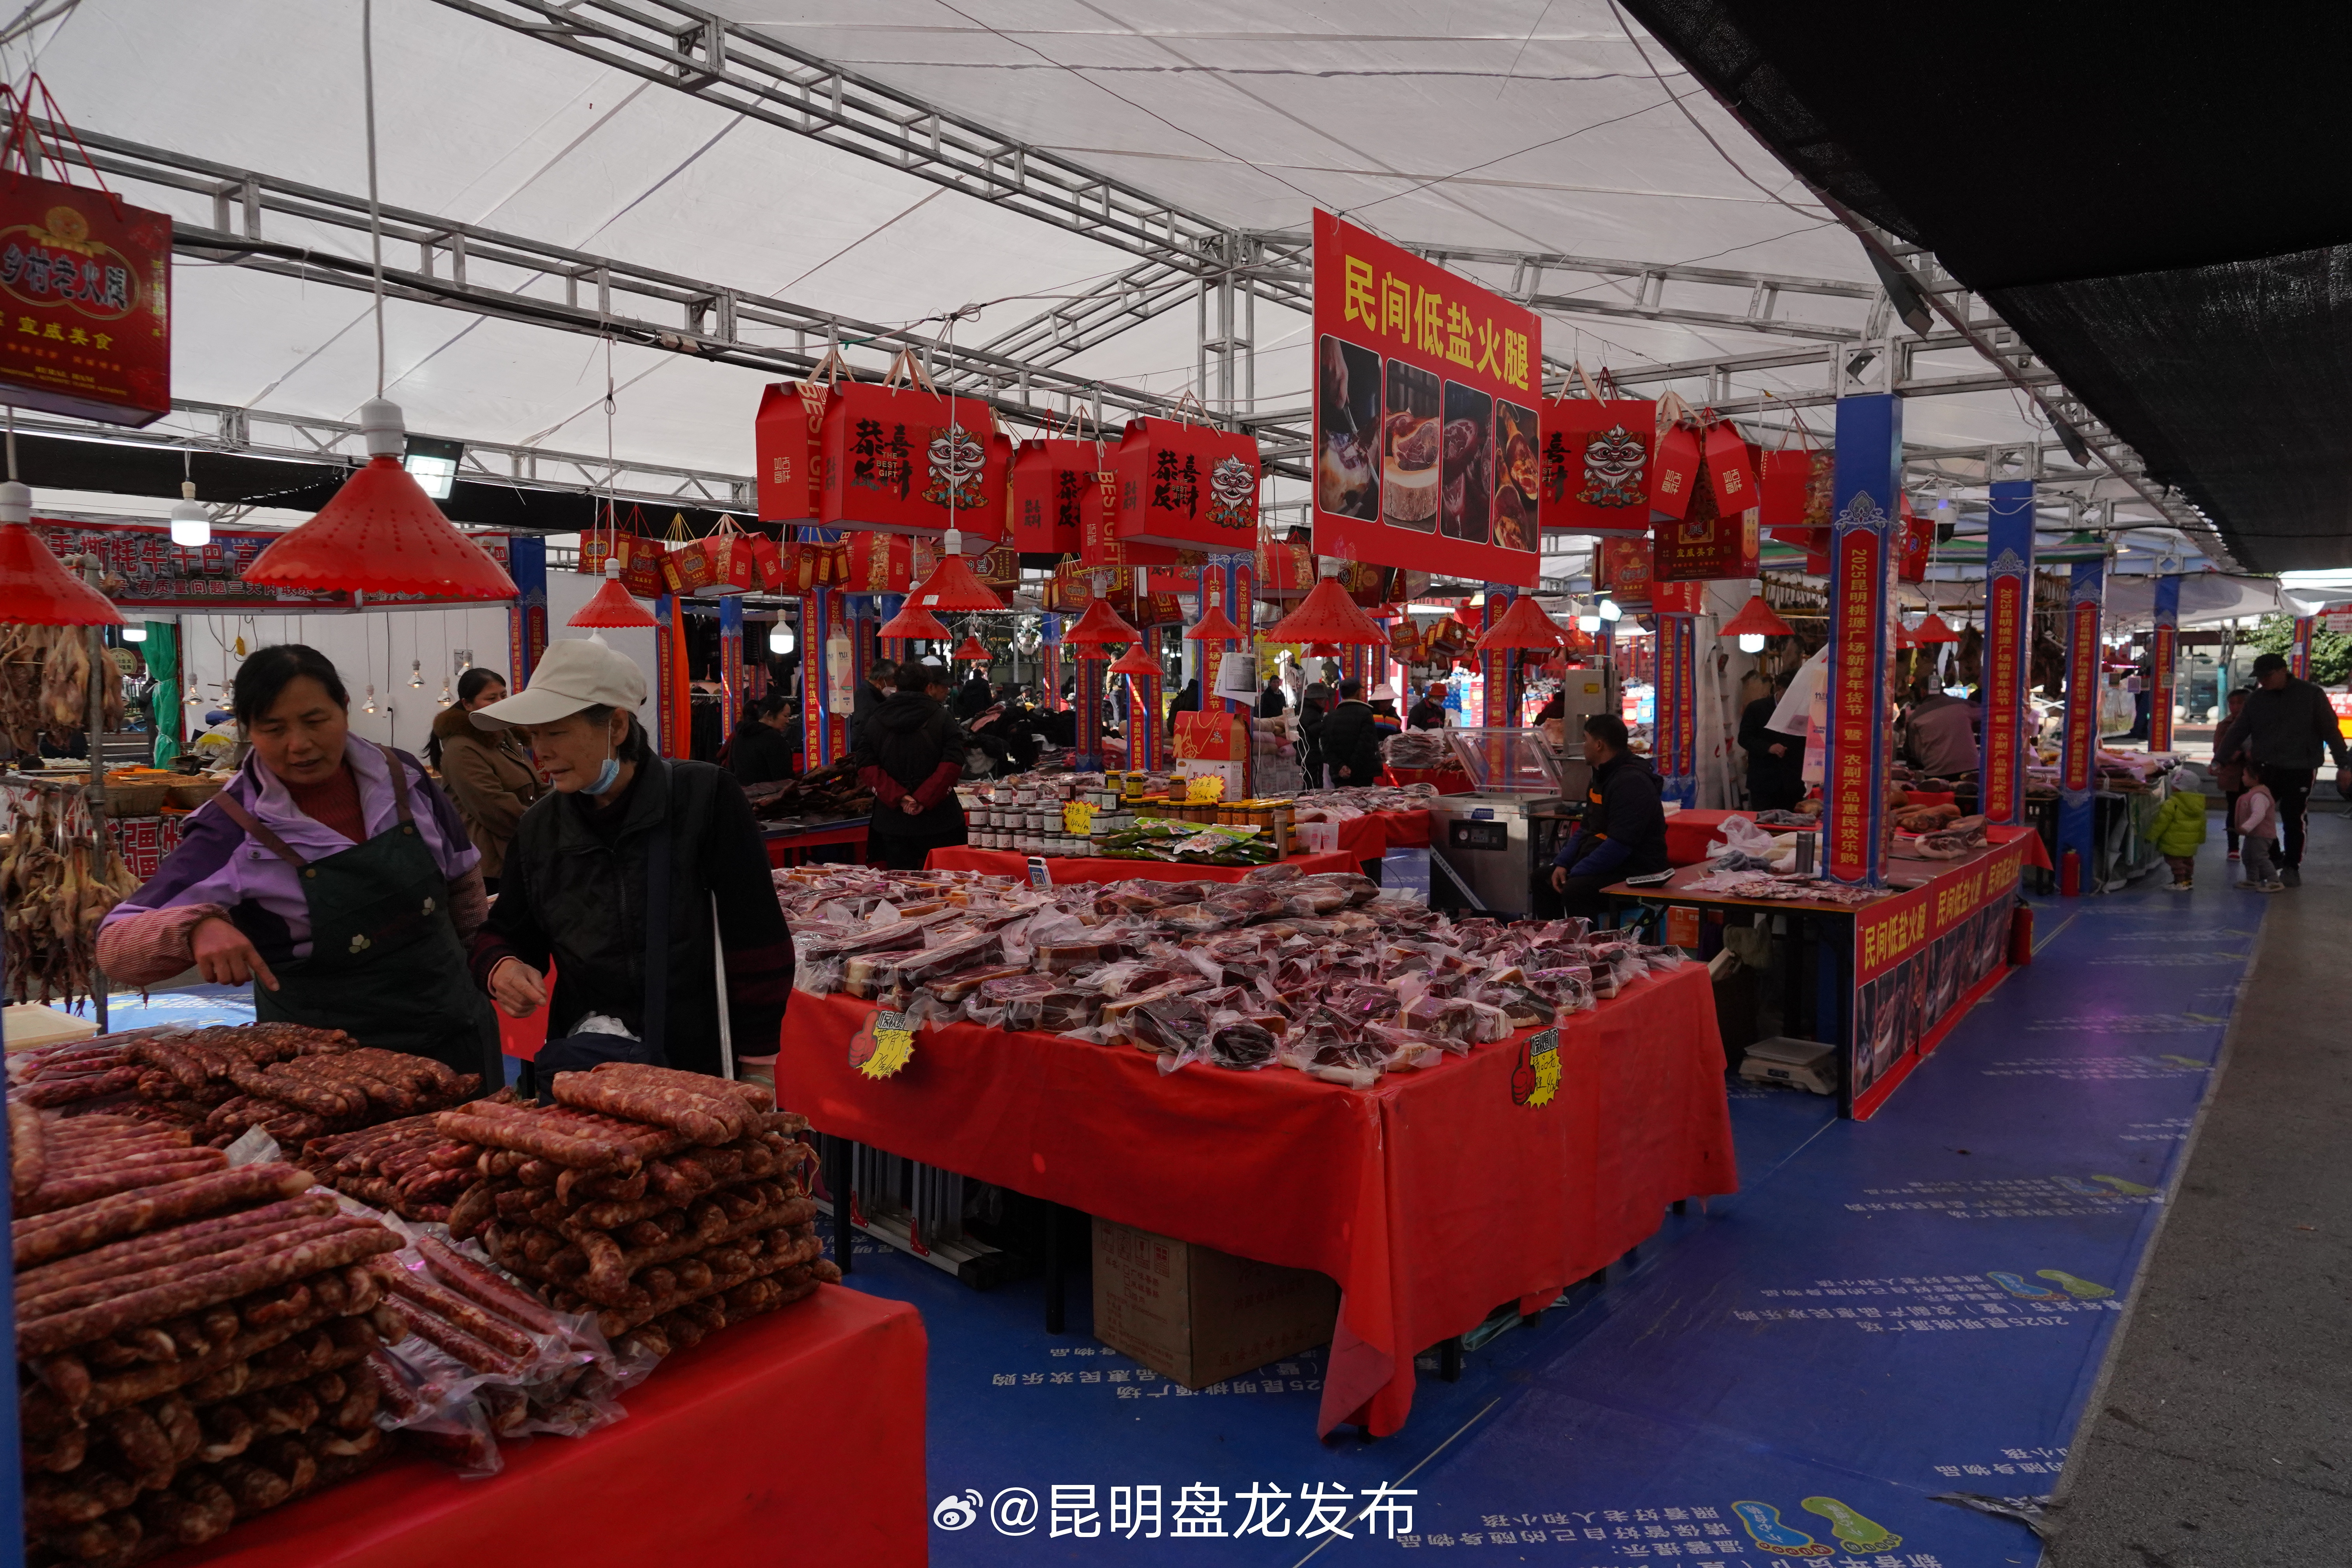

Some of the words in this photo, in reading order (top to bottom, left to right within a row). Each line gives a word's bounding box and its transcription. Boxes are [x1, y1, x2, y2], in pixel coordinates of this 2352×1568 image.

[1, 244, 128, 311] 乡村老火腿
[18, 316, 114, 350] 宣威美食
[1344, 254, 1529, 391] 民间低盐火腿
[882, 451, 898, 459] THE
[878, 469, 898, 478] GIFT
[1677, 546, 1715, 558] 宣威美食
[1840, 549, 1868, 865] 2025昆明桃源广场新春年货节（暨）农副产品惠民欢乐购
[1936, 872, 1984, 929] 民间低盐火腿
[1864, 902, 1927, 971] 民间低盐火腿
[877, 1010, 916, 1031] 惊爆
[1530, 1027, 1559, 1056] 惊爆价
[1117, 1379, 1325, 1399] 25昆明桃源广场
[1481, 1506, 1720, 1528] 照看好老人和小孩
[1396, 1522, 1731, 1548] 请保管好自己的随身物品
